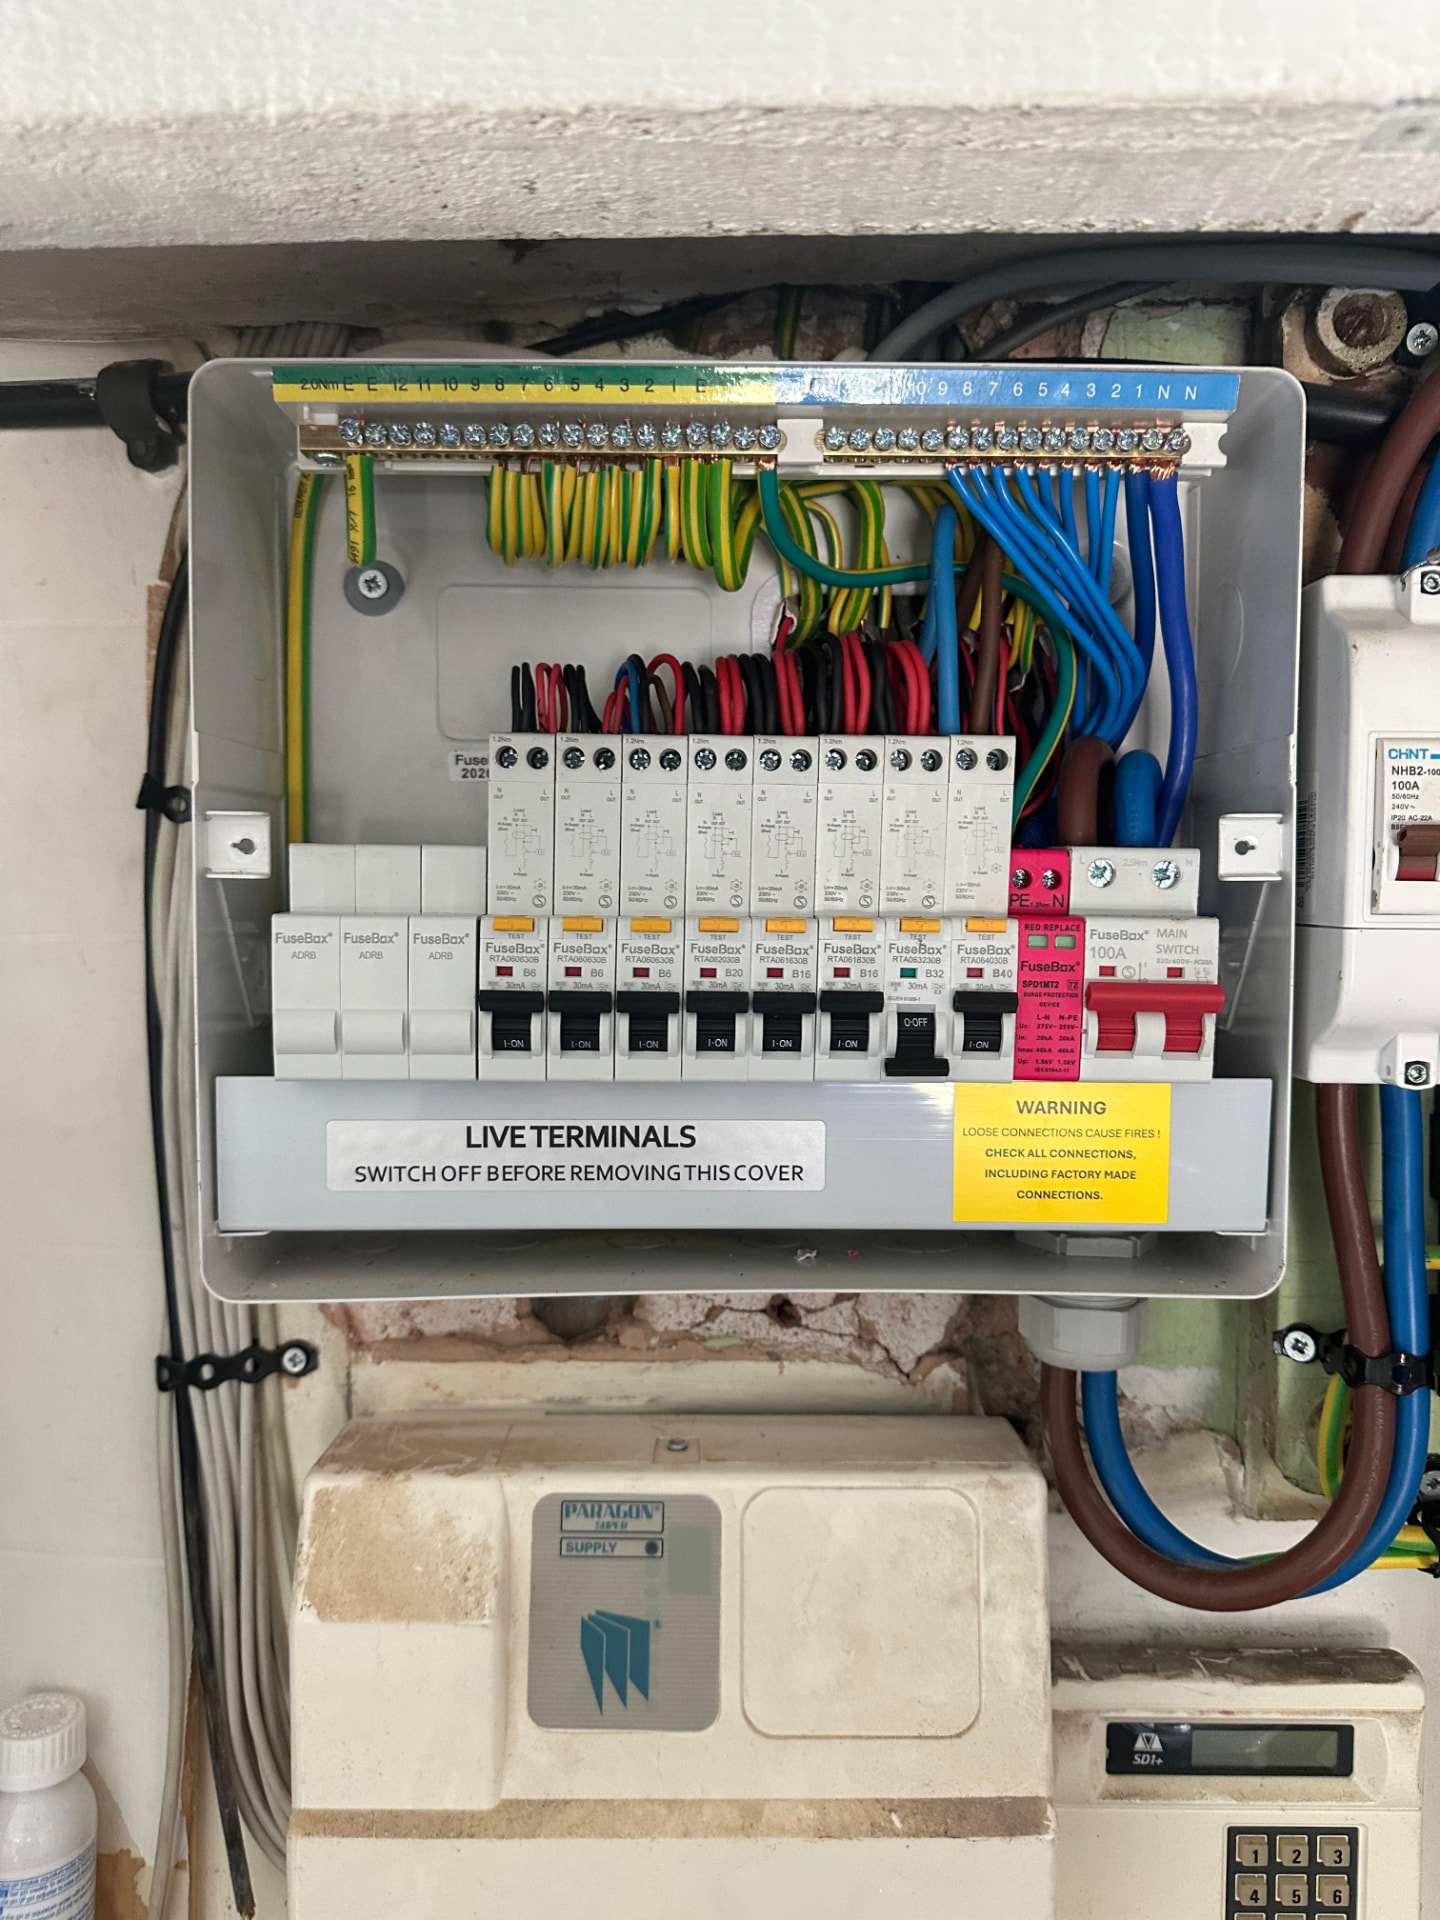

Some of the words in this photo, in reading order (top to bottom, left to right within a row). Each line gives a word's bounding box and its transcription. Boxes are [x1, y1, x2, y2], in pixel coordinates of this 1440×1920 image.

[301, 378, 338, 390] 2.0Nm
[344, 377, 354, 391] E
[367, 377, 378, 391] E
[394, 377, 408, 391] 12
[419, 377, 431, 391] 11
[443, 377, 458, 391] 10
[471, 377, 480, 391] 9
[495, 377, 505, 391] 8
[520, 378, 529, 391] 7
[544, 377, 554, 392] 6
[571, 378, 580, 391] 5
[595, 378, 605, 391] 4
[620, 378, 629, 392] 3
[645, 378, 654, 392] 2
[696, 378, 706, 393] E
[939, 381, 948, 396] 9
[963, 381, 972, 396] 8
[989, 382, 998, 396] 7
[1013, 382, 1023, 397] 6
[1038, 382, 1048, 397] 5
[1061, 383, 1070, 397] 4
[1086, 382, 1096, 397] 3
[1111, 383, 1121, 398] 2
[1136, 383, 1141, 398] 1
[1158, 385, 1170, 399] N
[1185, 385, 1197, 400] N
[455, 754, 489, 766] Fuse
[1392, 781, 1420, 790] 100A
[1009, 893, 1030, 907] PE
[1053, 894, 1064, 908] N
[1156, 928, 1188, 938] MAIN
[1090, 946, 1127, 959] 100A
[1156, 944, 1199, 955] SWITCH
[291, 951, 316, 959] ADRB
[359, 951, 383, 959] ADRB
[429, 952, 453, 960] ADRB
[523, 968, 536, 977] B6
[591, 969, 604, 977] B6
[659, 969, 671, 977] B6
[725, 968, 743, 977] B20
[792, 970, 811, 979] B16
[860, 969, 878, 978] B16
[925, 969, 944, 978] B32
[993, 969, 1013, 978] B40
[641, 982, 661, 990] 30mA
[708, 981, 727, 989] 30mA
[842, 982, 862, 990] 30mA
[908, 982, 928, 990] 30mA
[1022, 981, 1059, 989] SPD1MT2
[1016, 1100, 1107, 1115] WARNING
[466, 1126, 526, 1148] LIVE
[530, 1125, 696, 1148] TERMINALS
[963, 1127, 999, 1137] LOOSE
[1001, 1128, 1083, 1138] CONNECTIONS
[1085, 1129, 1122, 1138] CAUSE
[1125, 1129, 1155, 1138] FIRES
[985, 1148, 1025, 1157] CHECK
[1027, 1149, 1047, 1158] ALL
[1049, 1149, 1136, 1160] CONNECTIONS,
[355, 1166, 436, 1182] SWITCH
[441, 1165, 481, 1182] OFF
[487, 1165, 566, 1181] BEFORE
[570, 1165, 681, 1181] REMOVING
[684, 1165, 730, 1181] THIS
[734, 1165, 804, 1181] COVER
[985, 1169, 1048, 1178] INCLUDING
[1051, 1170, 1101, 1179] FACTORY
[1104, 1170, 1136, 1180] MADE
[1016, 1190, 1103, 1200] CONNECTIONS.
[566, 1541, 617, 1553] SUPPLY
[1132, 1753, 1163, 1765] SD1+
[1252, 1849, 1259, 1864] 1
[1292, 1849, 1302, 1864] 2
[1333, 1849, 1343, 1864] 3
[1250, 1889, 1260, 1903] 4
[1292, 1889, 1301, 1904] 5
[1333, 1889, 1342, 1904] 6
